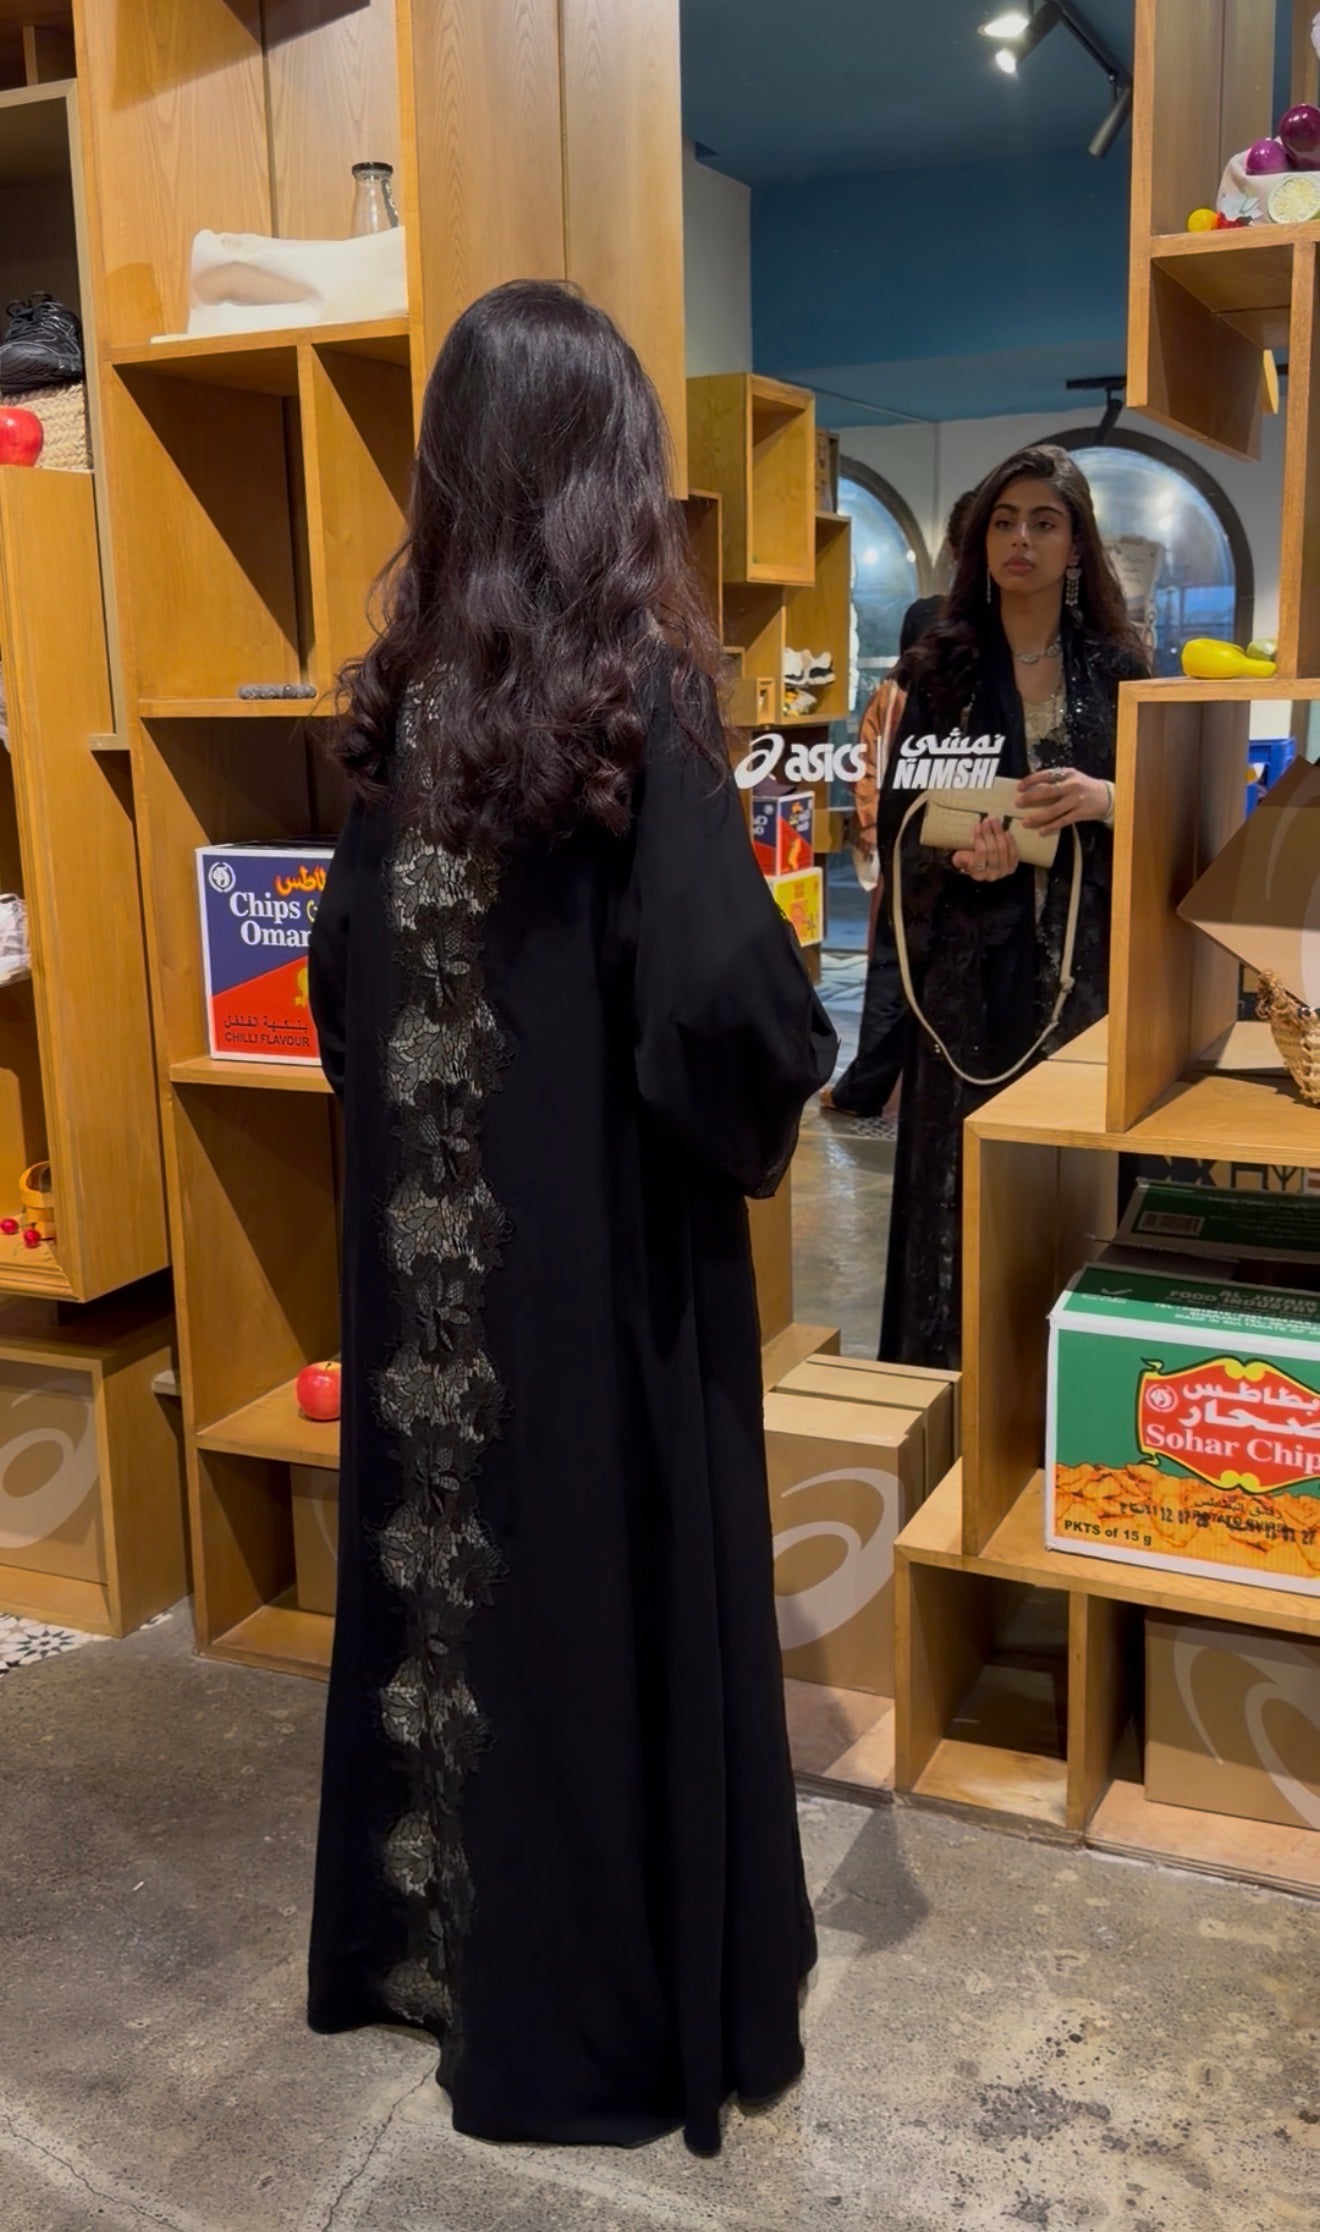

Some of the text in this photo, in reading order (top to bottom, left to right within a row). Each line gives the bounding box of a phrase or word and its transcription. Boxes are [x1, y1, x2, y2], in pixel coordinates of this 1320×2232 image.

[784, 743, 868, 783] asics
[892, 756, 999, 790] NAMSHI
[229, 891, 302, 925] Chips
[224, 1031, 311, 1047] CHILLI FLAVOUR
[1168, 1289, 1218, 1302] FOOD
[1183, 1381, 1320, 1416] بطاطس
[1145, 1423, 1241, 1457] Sohar
[1064, 1519, 1153, 1547] PKTS of 15 g
